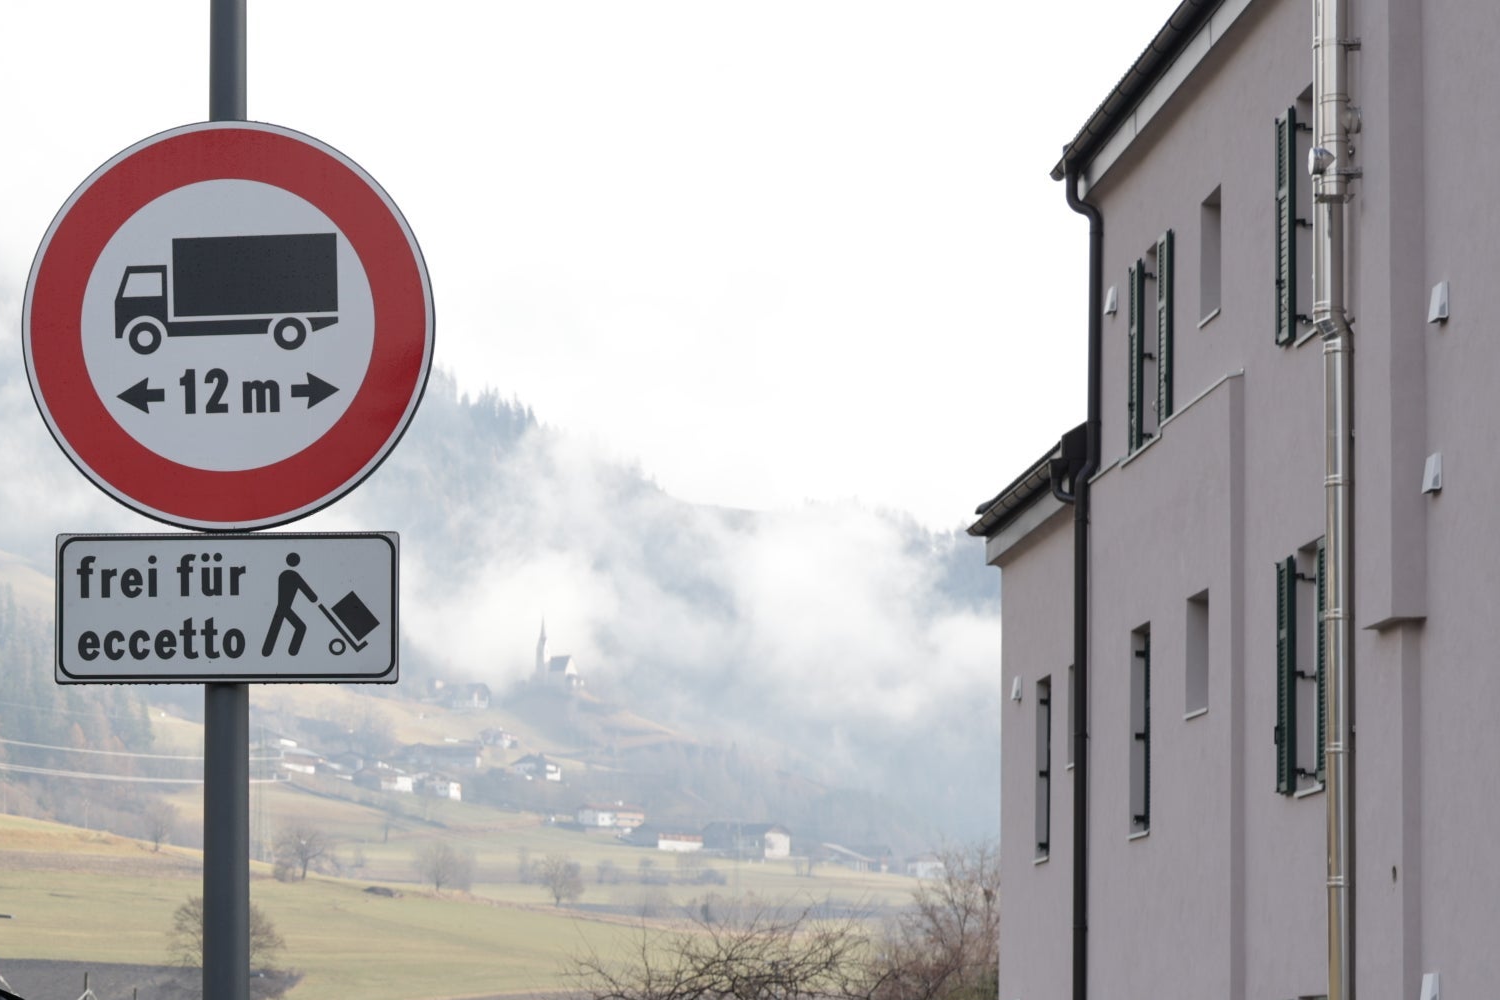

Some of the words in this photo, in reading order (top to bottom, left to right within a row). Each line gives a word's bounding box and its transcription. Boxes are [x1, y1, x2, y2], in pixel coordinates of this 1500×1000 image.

[179, 367, 229, 415] 12
[242, 378, 281, 414] m
[76, 554, 158, 599] frei
[176, 552, 247, 598] für
[77, 616, 246, 664] eccetto
